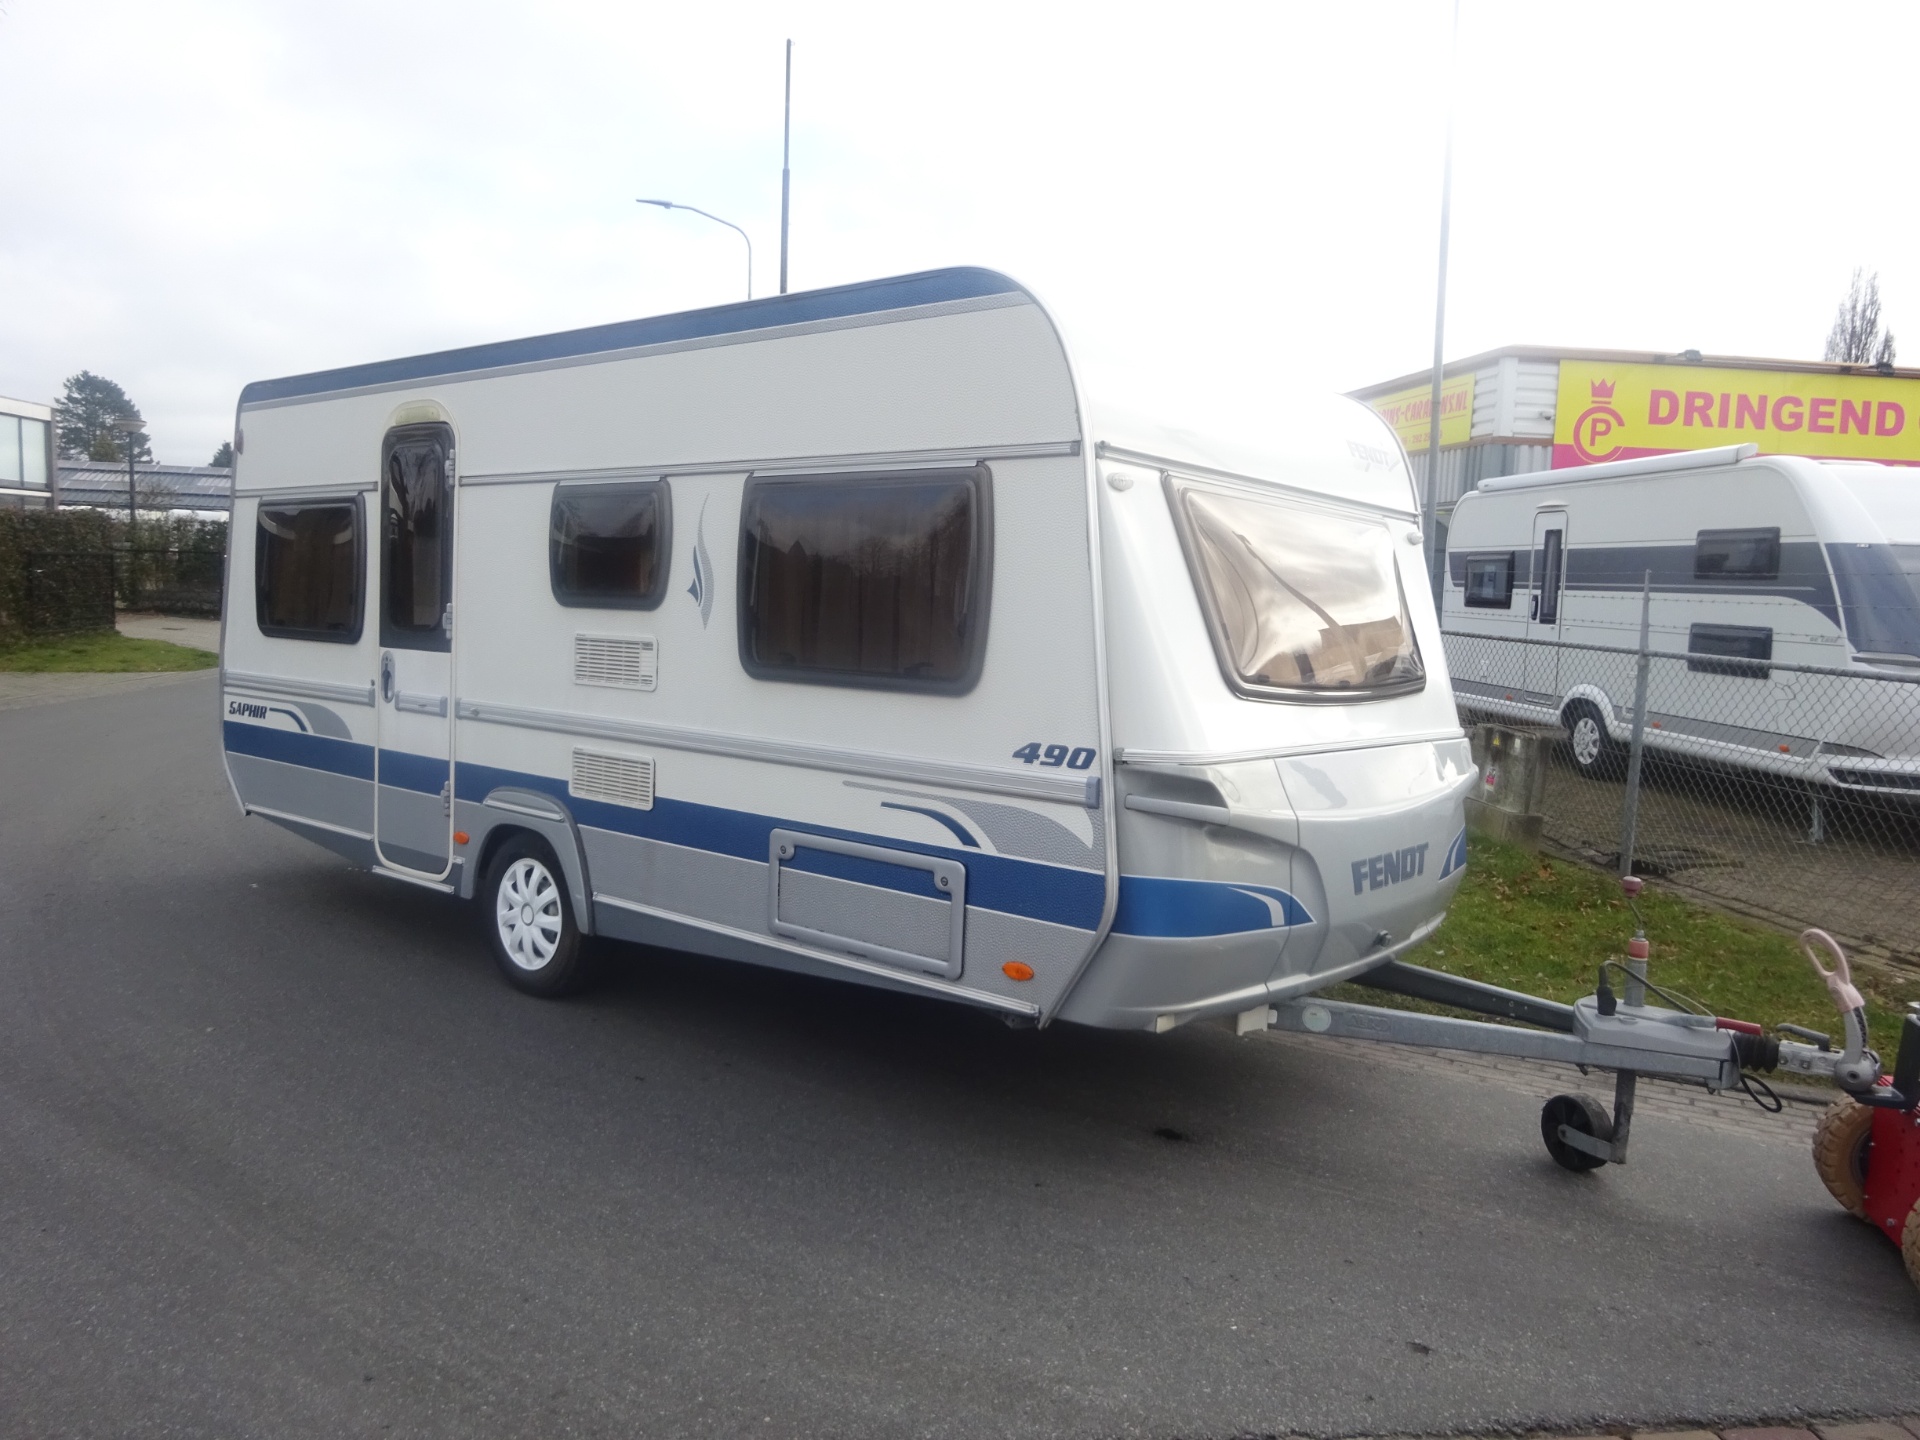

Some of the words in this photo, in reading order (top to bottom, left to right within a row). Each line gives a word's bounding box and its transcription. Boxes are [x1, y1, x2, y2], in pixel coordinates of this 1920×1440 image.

[1648, 389, 1905, 437] DRINGEND
[228, 700, 268, 720] SAPHIR
[1012, 742, 1097, 770] 490
[1350, 841, 1429, 896] FENDT
